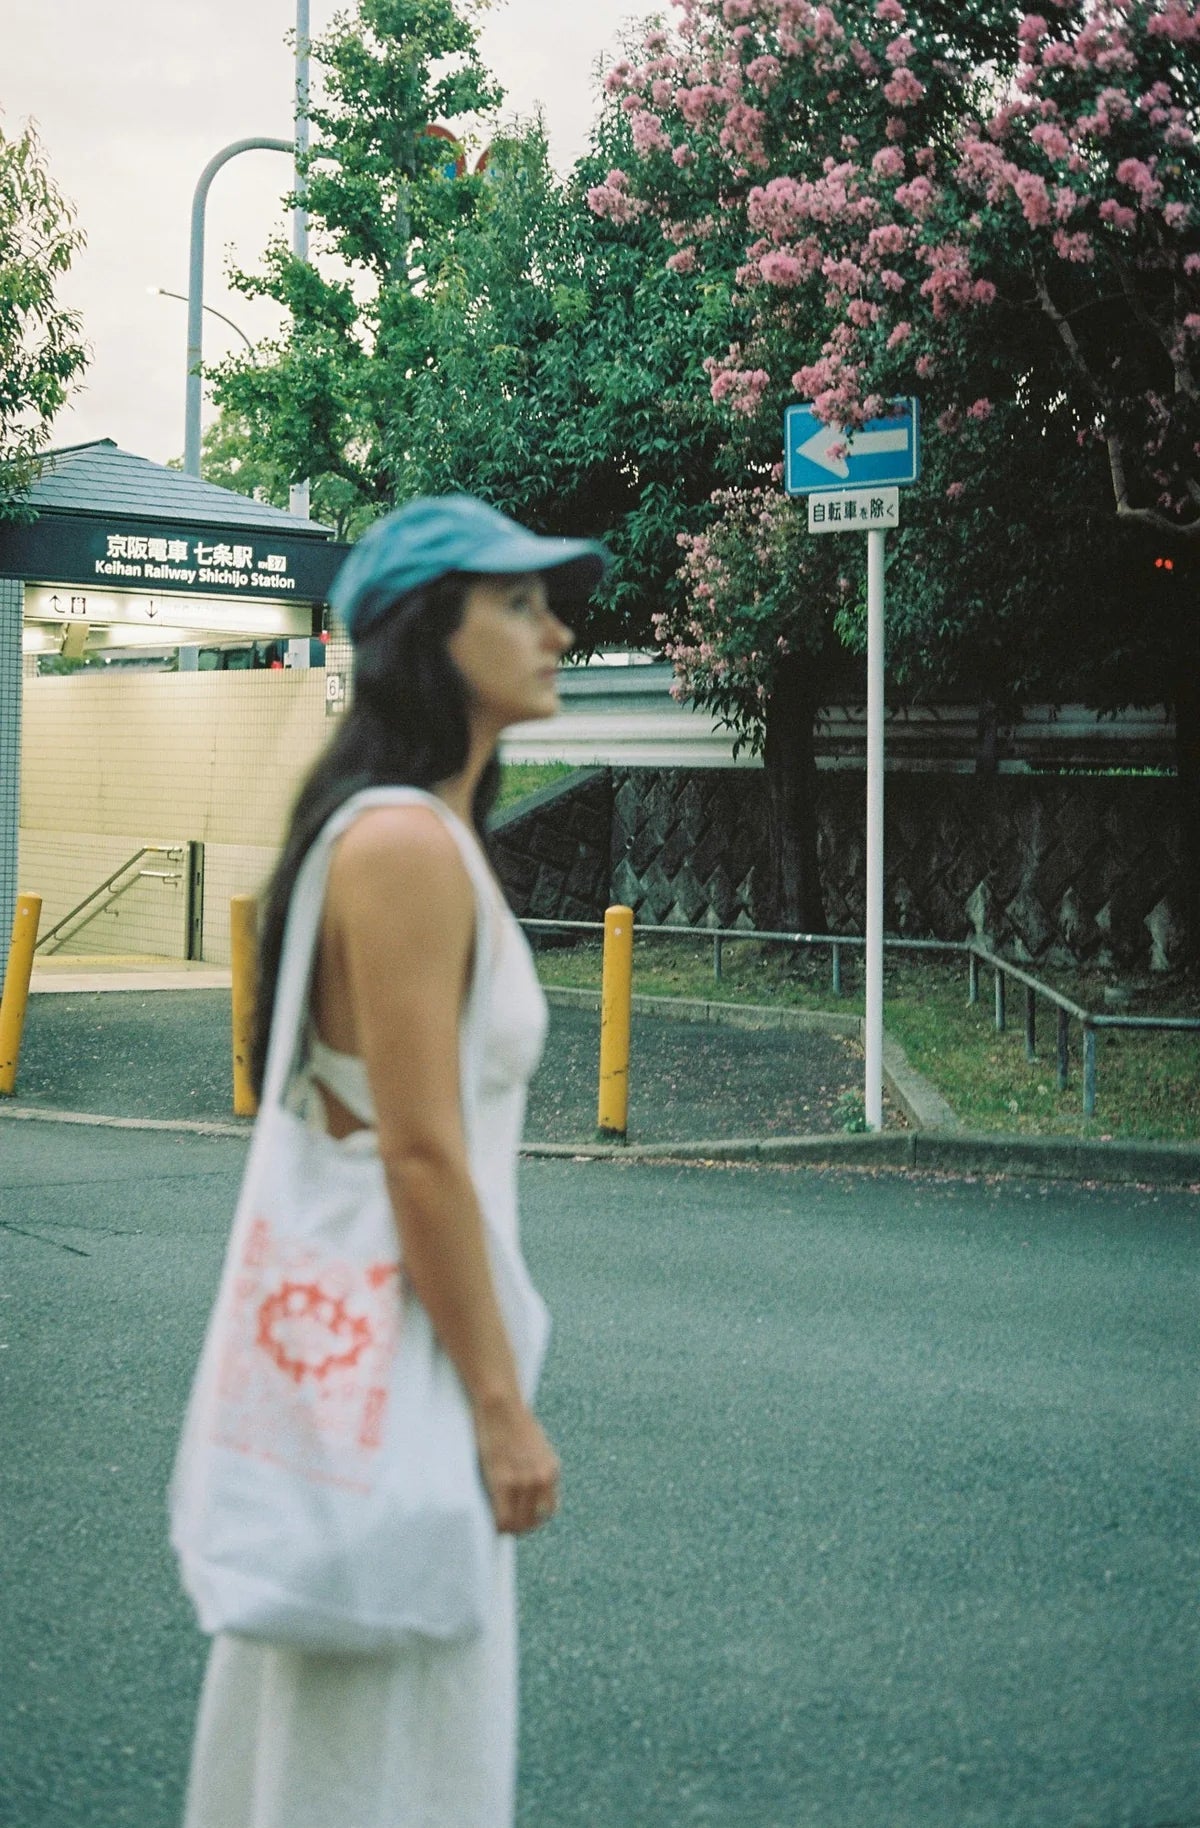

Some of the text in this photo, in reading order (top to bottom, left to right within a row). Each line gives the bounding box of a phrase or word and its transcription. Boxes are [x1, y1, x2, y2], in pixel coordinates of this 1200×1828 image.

[813, 498, 895, 522] 自転車を除く
[106, 534, 188, 563] 京阪電車
[194, 542, 253, 569] 七条駅
[95, 560, 295, 589] Keihan Railway Shichijo Station
[330, 680, 336, 696] 6
